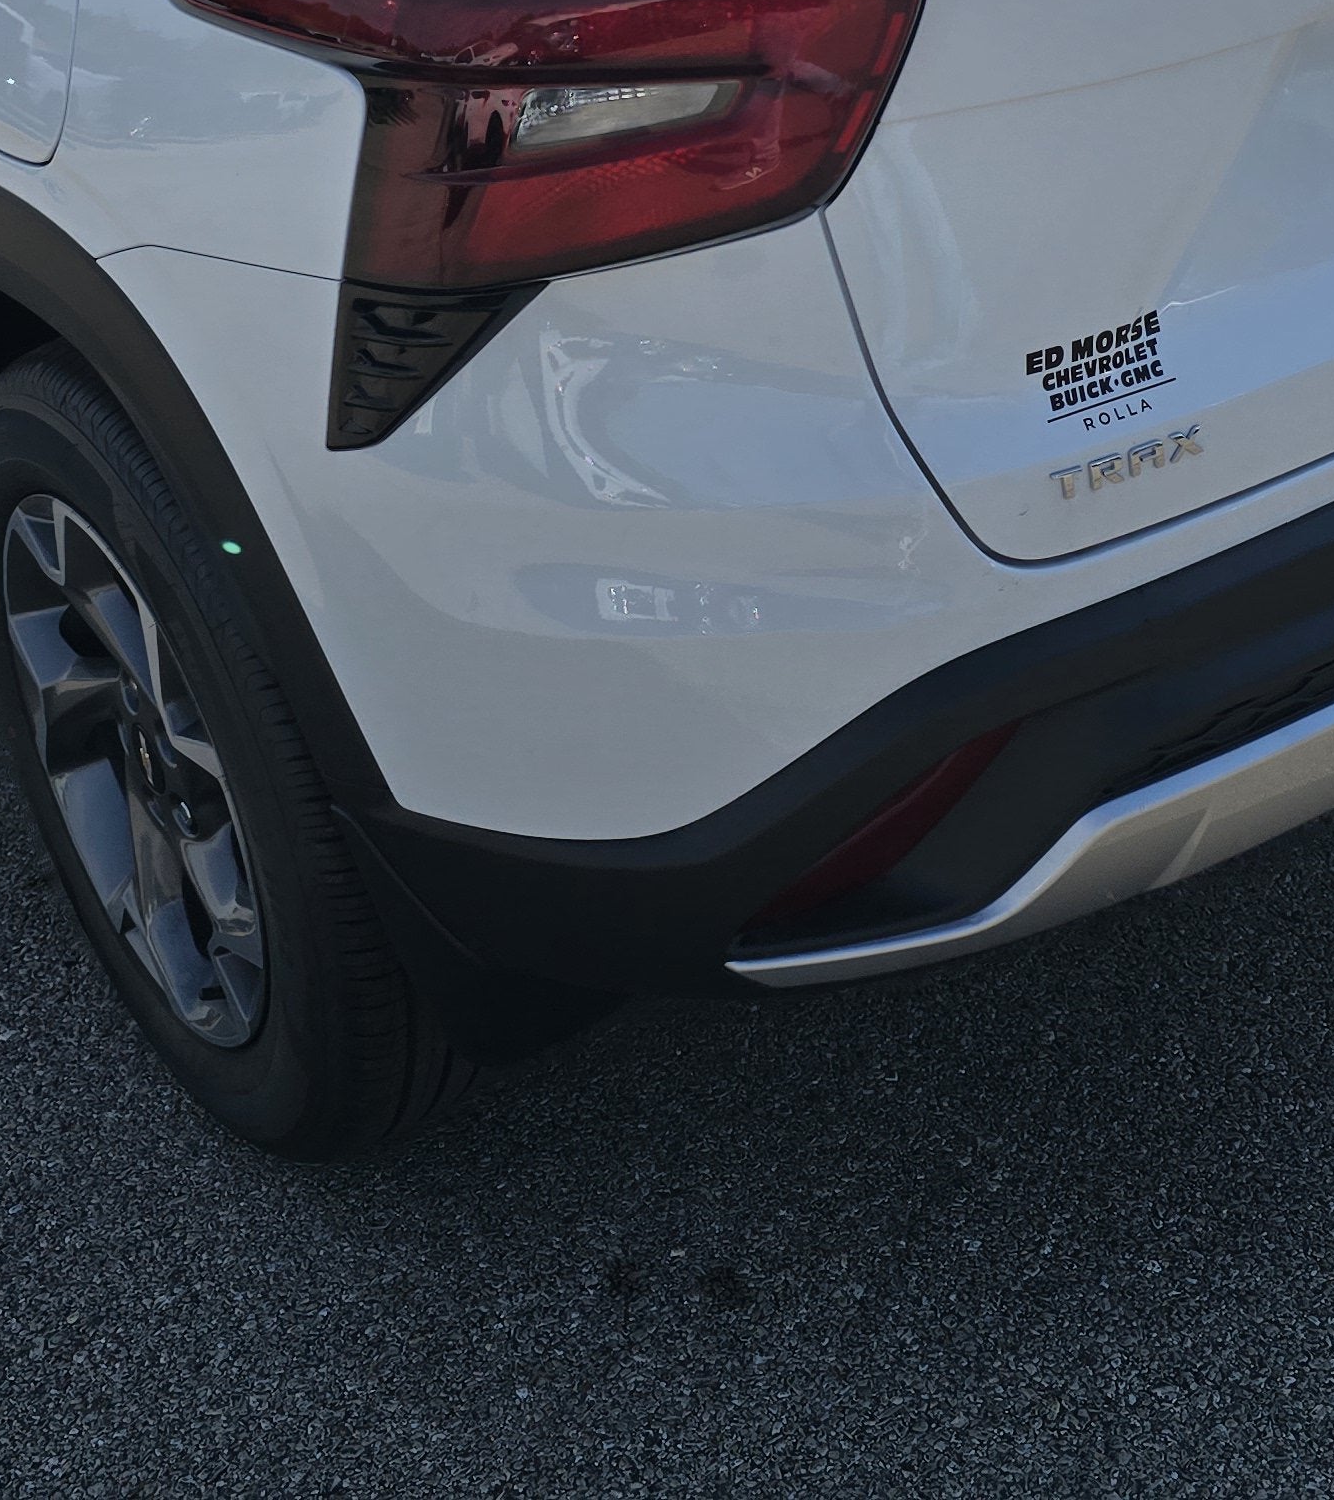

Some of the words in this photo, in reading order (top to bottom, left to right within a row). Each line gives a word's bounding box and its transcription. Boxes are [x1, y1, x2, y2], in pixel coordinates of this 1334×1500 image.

[1026, 345, 1064, 376] ED
[1071, 309, 1162, 363] MORSE
[1042, 337, 1158, 392] CHEVROLET
[1082, 398, 1153, 432] ROLLA
[1049, 423, 1206, 501] TRAX
